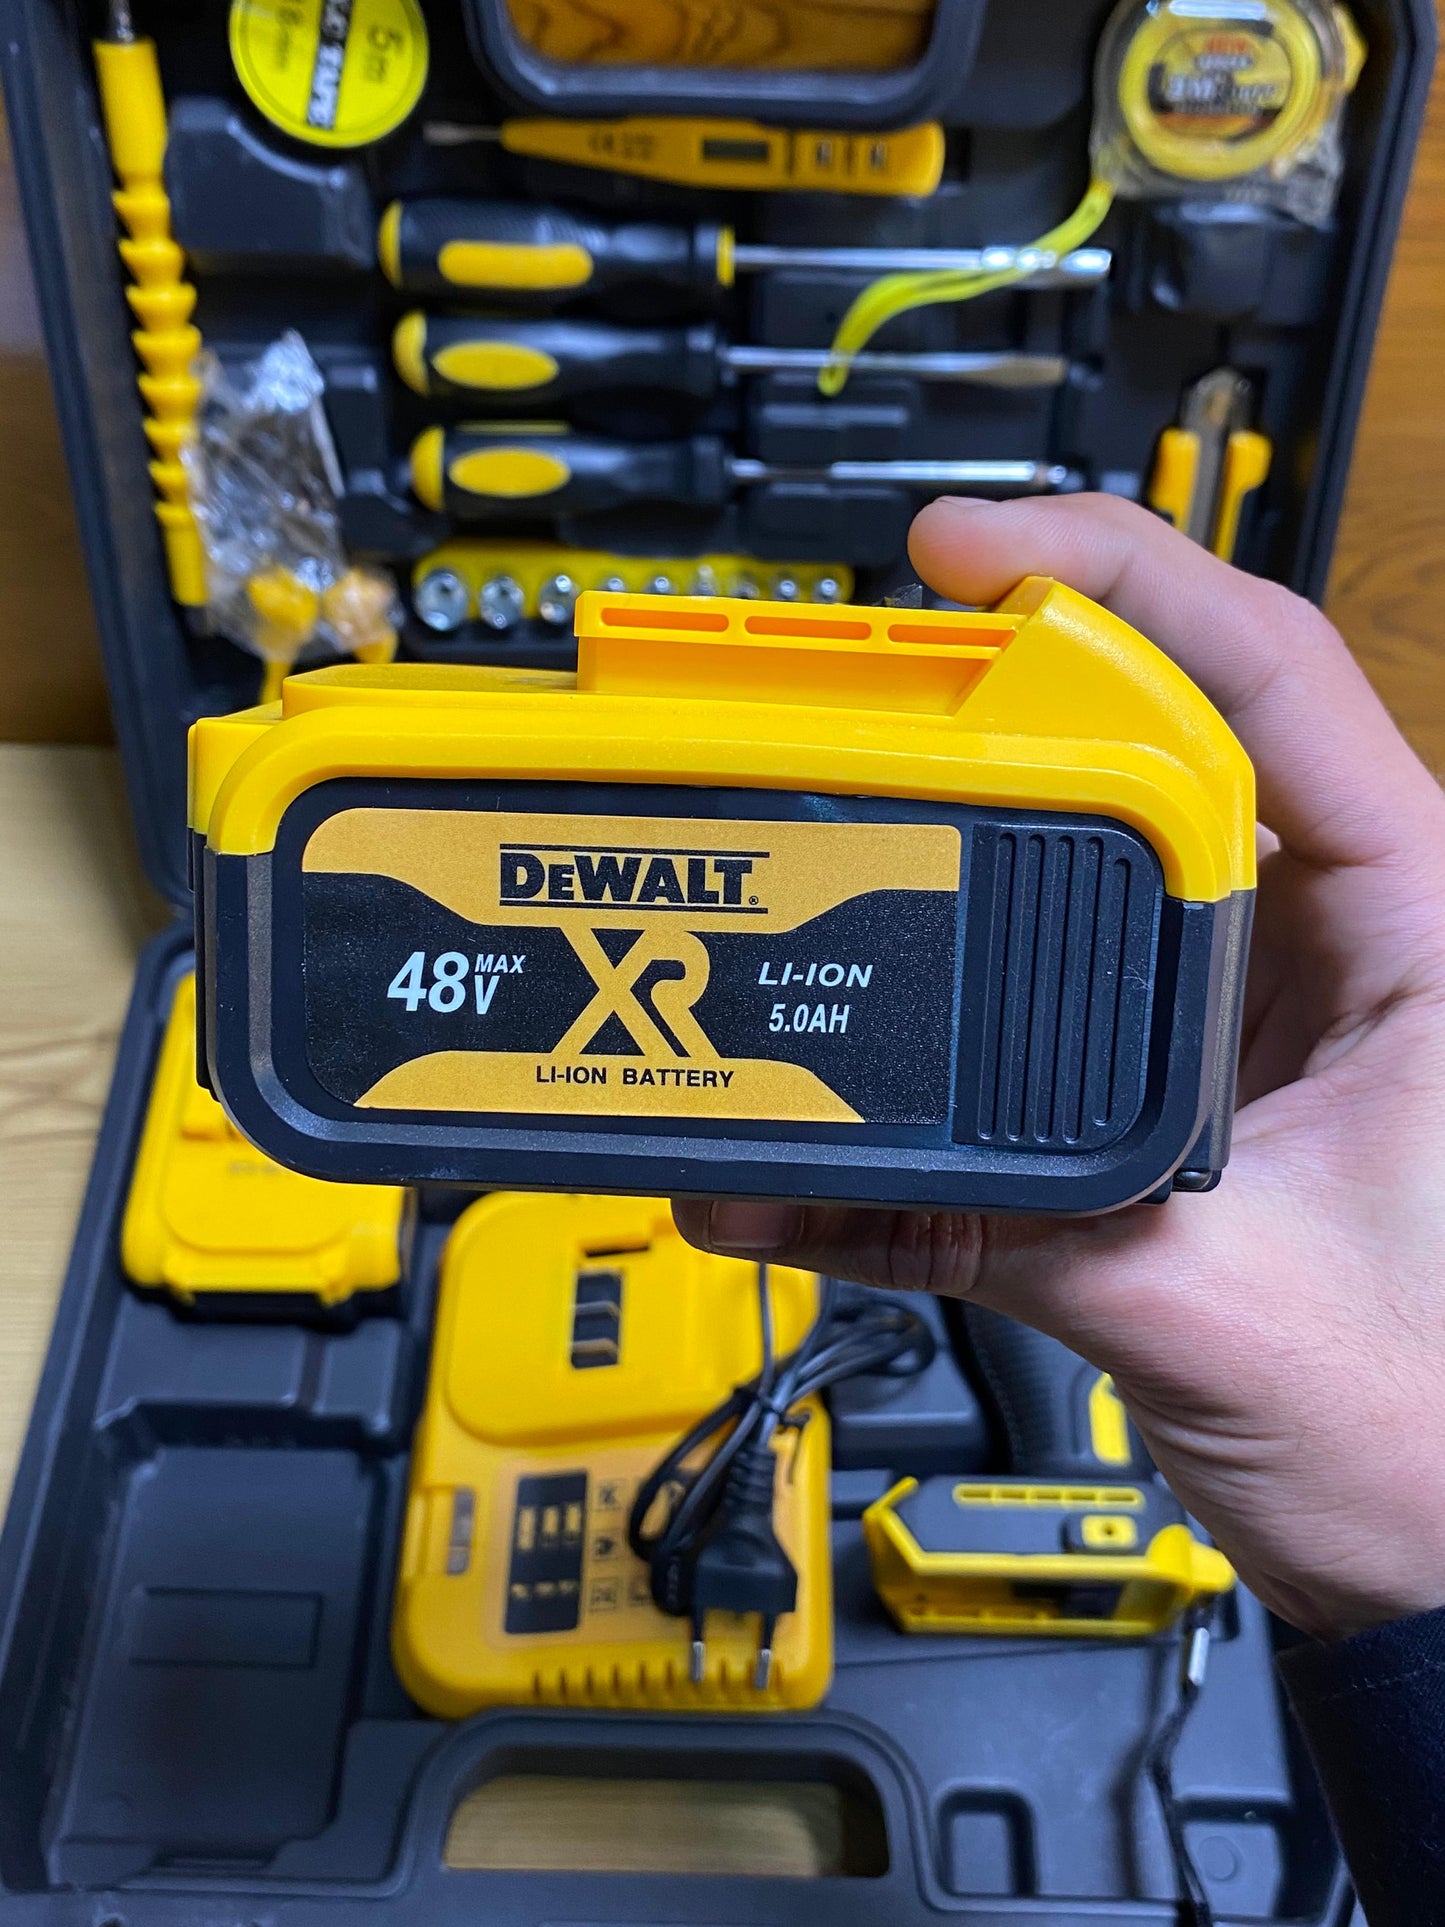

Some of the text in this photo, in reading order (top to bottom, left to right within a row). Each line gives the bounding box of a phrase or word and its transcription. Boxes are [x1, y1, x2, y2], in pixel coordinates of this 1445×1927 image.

[474, 953, 527, 974] MAX
[758, 961, 874, 988] LI-ION
[549, 925, 722, 1059] XR
[768, 1003, 850, 1034] 5.0AH
[536, 1065, 735, 1088] LI-ION BATTERY
